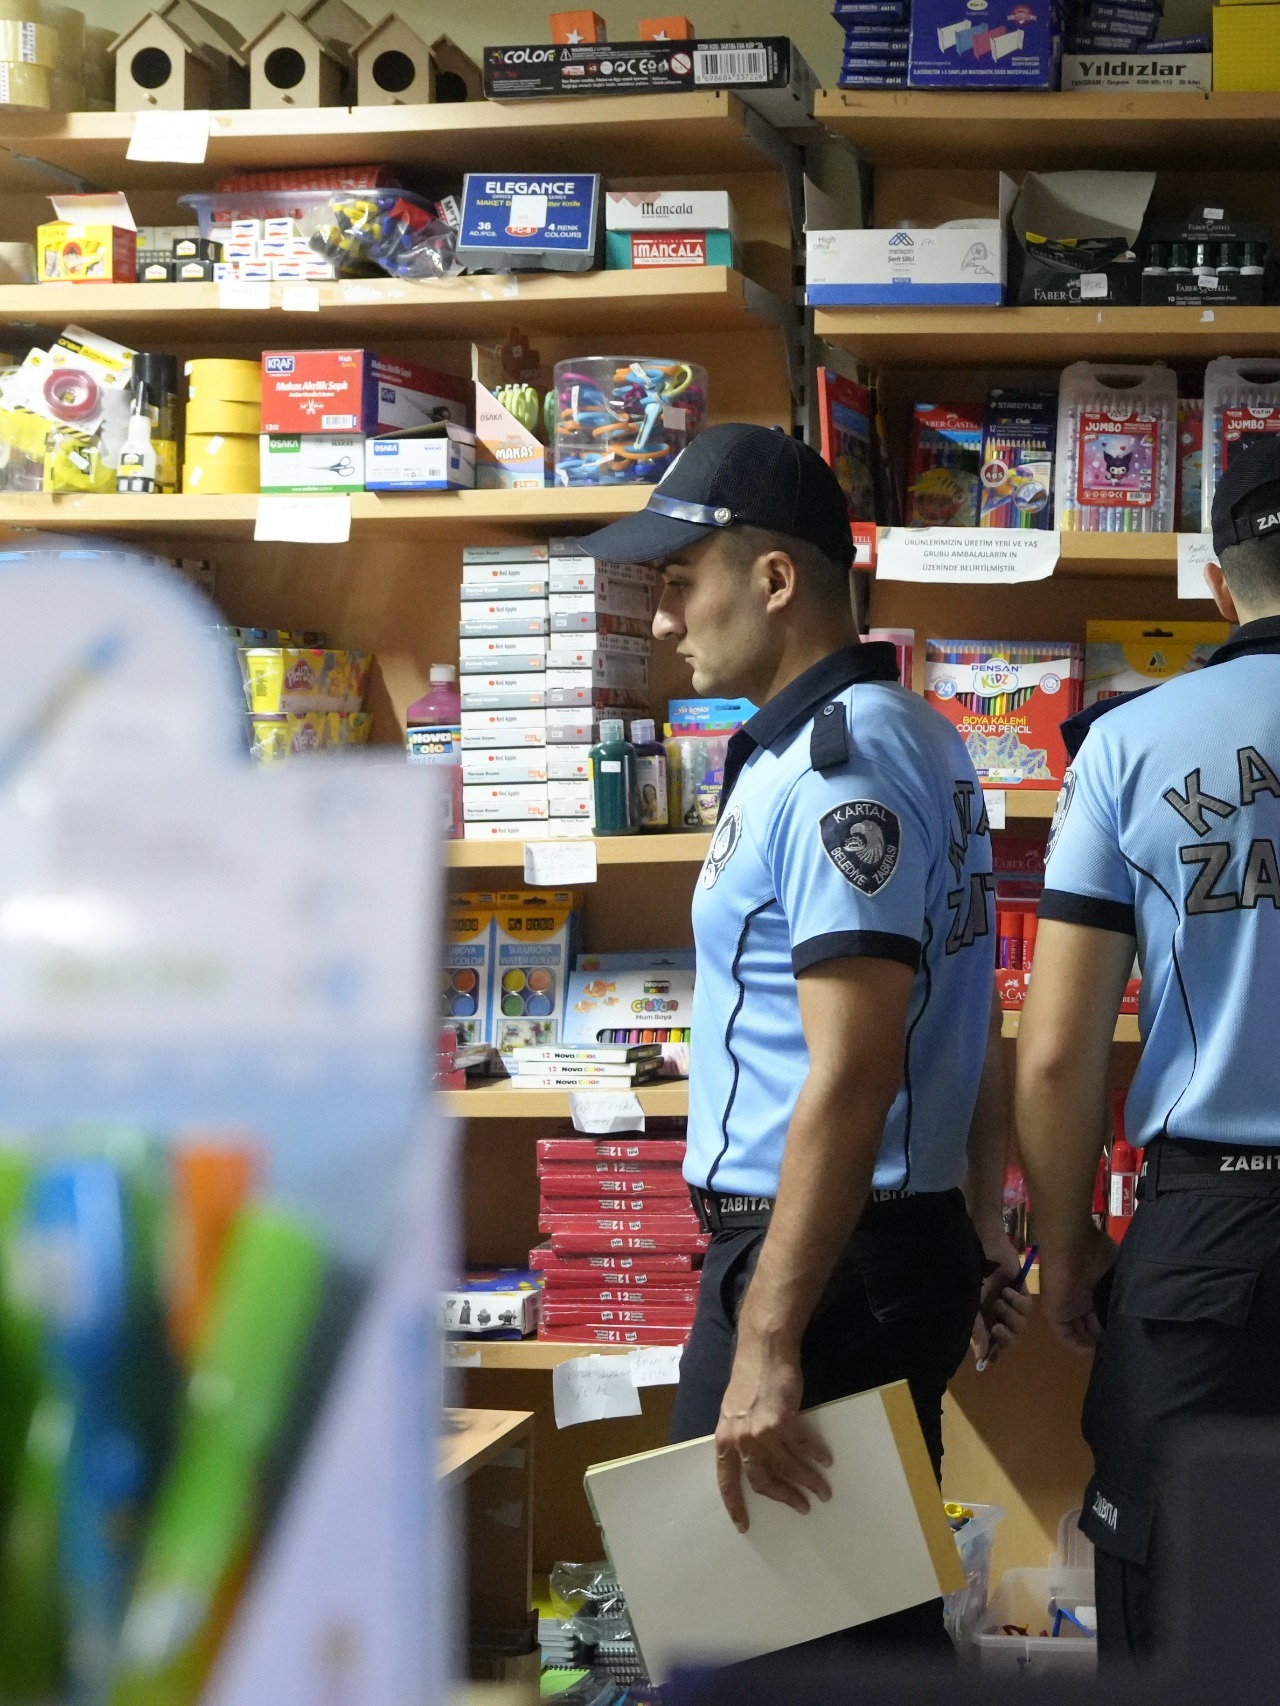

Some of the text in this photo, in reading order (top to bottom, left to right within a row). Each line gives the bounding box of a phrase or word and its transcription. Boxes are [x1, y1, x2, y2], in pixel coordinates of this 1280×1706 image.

[1079, 62, 1187, 76] Yıldızlar
[485, 182, 576, 195] ELEGANCE
[641, 202, 693, 215] Mancala
[477, 222, 492, 230] 36
[557, 224, 579, 232] RENK
[638, 244, 704, 258] MANCALA
[266, 358, 293, 371] KRAF
[276, 381, 302, 391] Makas
[303, 380, 328, 391] Akrilik
[480, 414, 503, 422] OSAKA
[1086, 422, 1122, 432] JUMBO
[1228, 420, 1264, 430] JUMBO
[270, 440, 299, 448] OSAKA
[374, 445, 398, 453] OSAKA
[496, 445, 534, 460] MAKAS
[904, 538, 963, 546] ÜRÜNLERİMİZİN
[964, 538, 993, 547] ÜRETİM
[1024, 540, 1038, 549] YAŞ
[924, 550, 950, 558] GRUBU
[922, 564, 1018, 574] ÜZERİNDE BELİRTİLMİŞTİR.
[505, 606, 517, 614] Apple
[971, 664, 1020, 672] PENSAN
[938, 682, 954, 696] 24
[962, 716, 1027, 725] BOYA KALEMİ
[956, 724, 1032, 734] COLOUR PENCIL
[413, 732, 451, 744] Nova
[832, 803, 888, 824] KARTAL
[508, 944, 552, 954] SULUBOYA
[501, 956, 560, 966] WATER COLOR
[631, 998, 678, 1012] Crayon
[614, 1162, 625, 1172] 12
[614, 1200, 626, 1210] 12
[720, 1197, 770, 1214] ZABITA
[628, 1238, 640, 1248] 12
[618, 1274, 630, 1284] 12
[618, 1310, 630, 1320] 12
[1092, 1490, 1118, 1531] ZABITA
